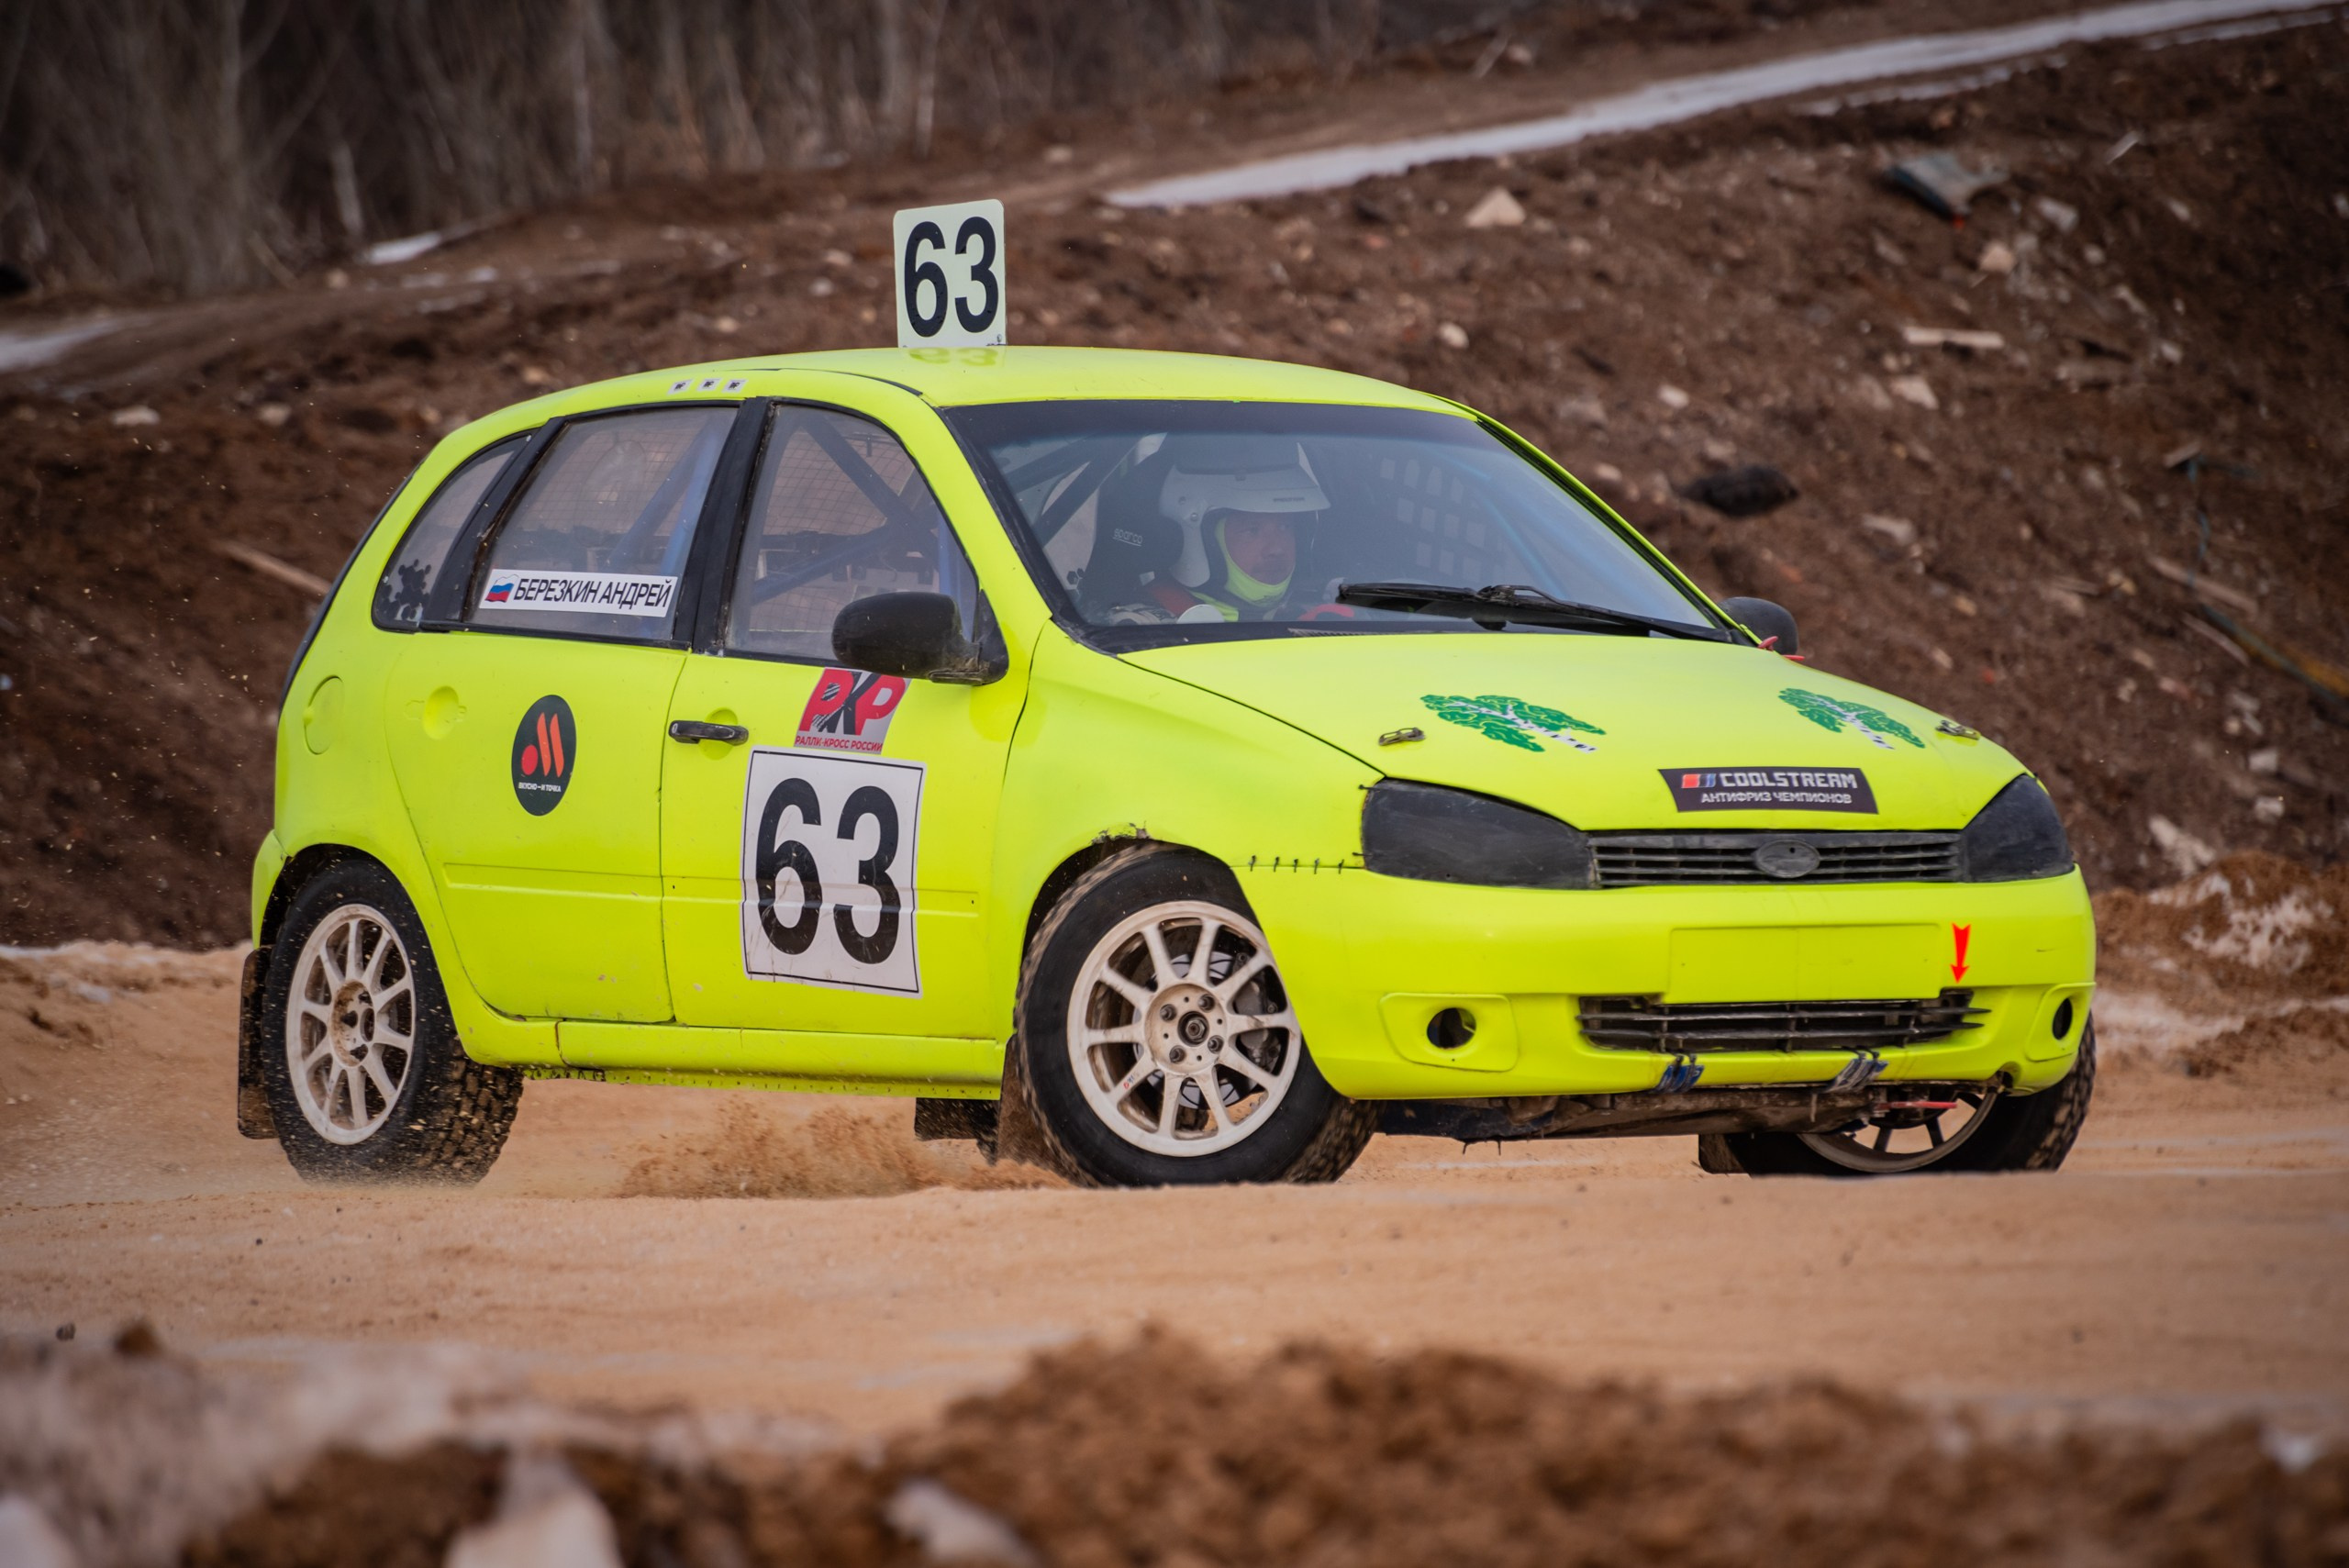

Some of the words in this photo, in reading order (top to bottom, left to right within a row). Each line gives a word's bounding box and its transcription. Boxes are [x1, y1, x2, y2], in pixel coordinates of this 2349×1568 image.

[904, 216, 999, 338] 63
[513, 578, 602, 603] БЕРЕЗКИН
[597, 579, 673, 609] АНДРЕЙ
[851, 740, 884, 751] РОССИИ
[1719, 772, 1858, 789] COOLSTREAM
[1701, 792, 1772, 804] АНТИФРИЗ
[1773, 792, 1853, 804] ЧЕМПИОНОВ
[755, 777, 901, 964] 63
